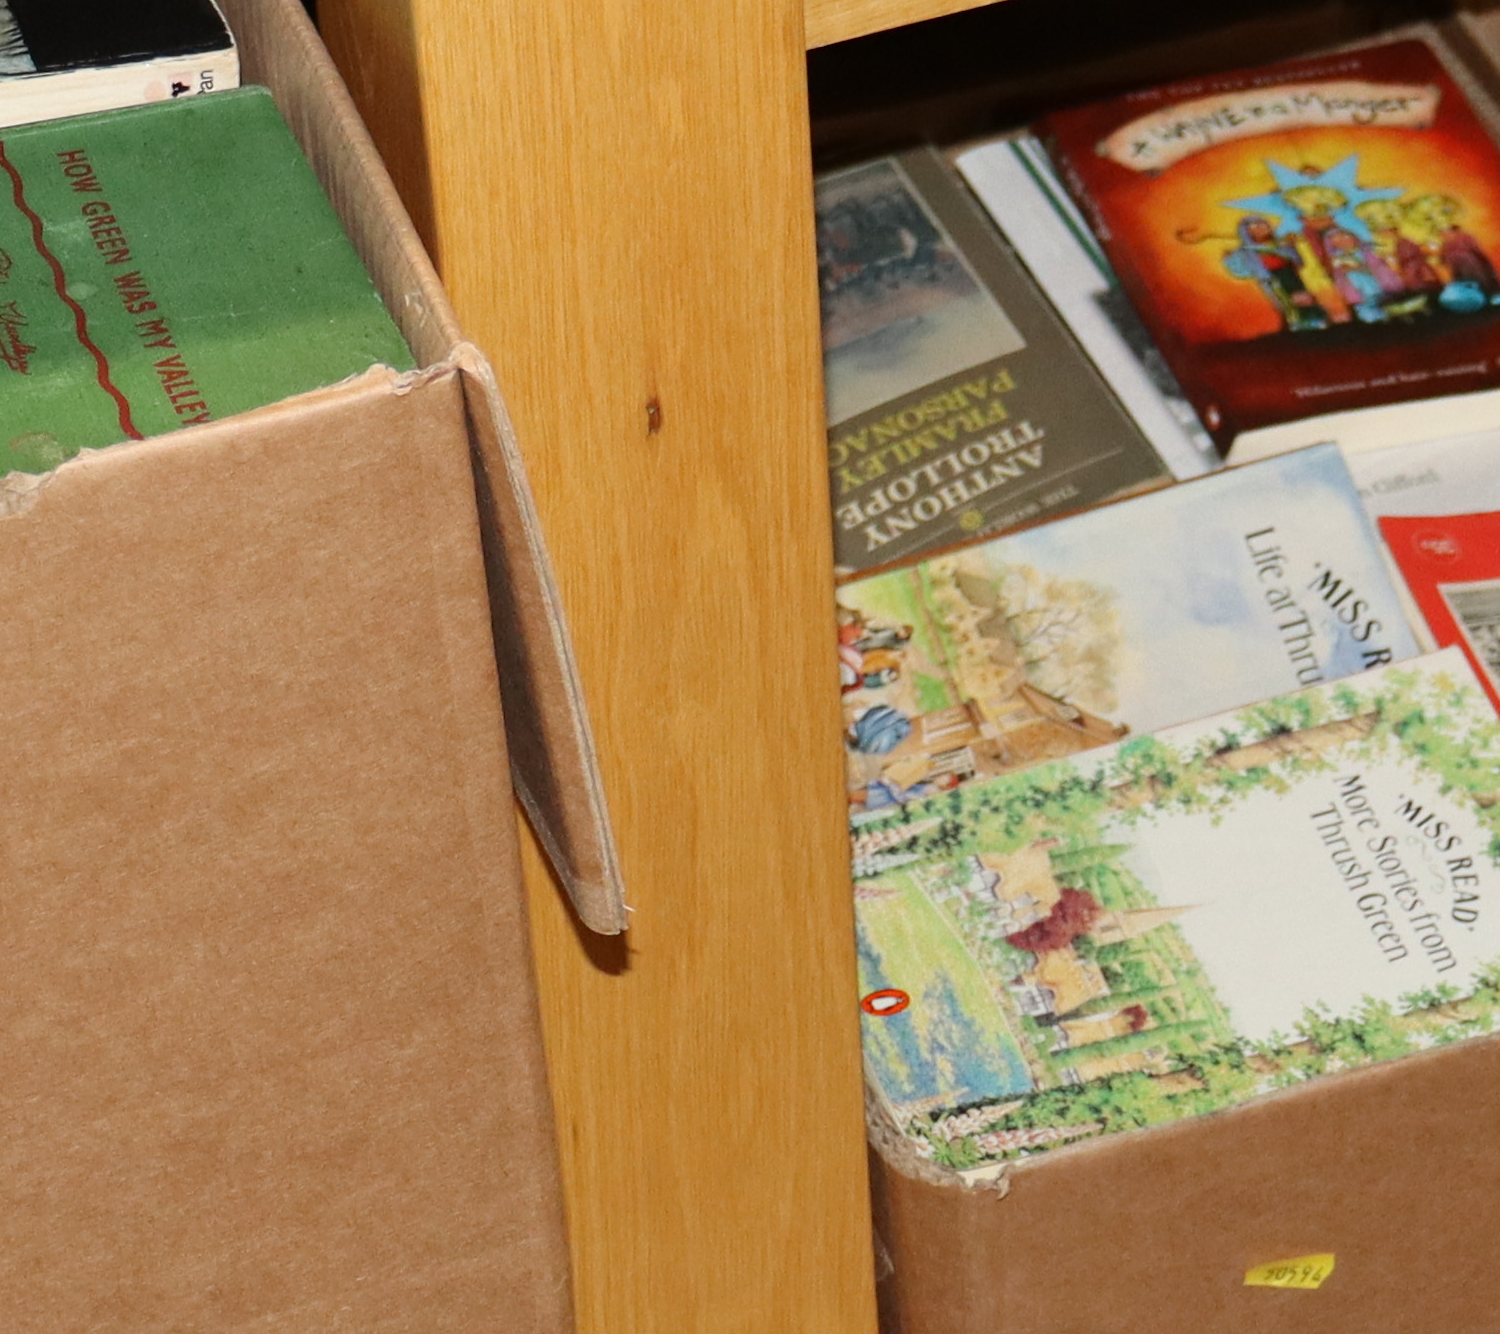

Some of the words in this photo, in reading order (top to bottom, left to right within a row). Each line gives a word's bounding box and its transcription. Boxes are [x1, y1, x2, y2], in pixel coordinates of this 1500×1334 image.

[199, 69, 214, 95] an
[57, 149, 103, 193] HOW
[81, 200, 133, 266] GREEN
[113, 270, 158, 315] WAS
[134, 317, 177, 349] MY
[153, 354, 214, 425] VALLEY
[835, 419, 1045, 531] TROLLOPE
[838, 400, 1009, 495] FRAMLEY
[865, 443, 1044, 553] ANTHONY
[1245, 527, 1286, 583] Life
[1266, 586, 1296, 613] at
[1308, 568, 1383, 643] MISS
[1278, 610, 1324, 686] Thru
[1310, 801, 1373, 892] Thrush
[1356, 891, 1409, 963] Green
[1333, 774, 1381, 833] More
[1366, 834, 1426, 913] Stories
[1409, 911, 1458, 974] from
[1394, 798, 1463, 853] MISS
[1446, 855, 1481, 925] READ
